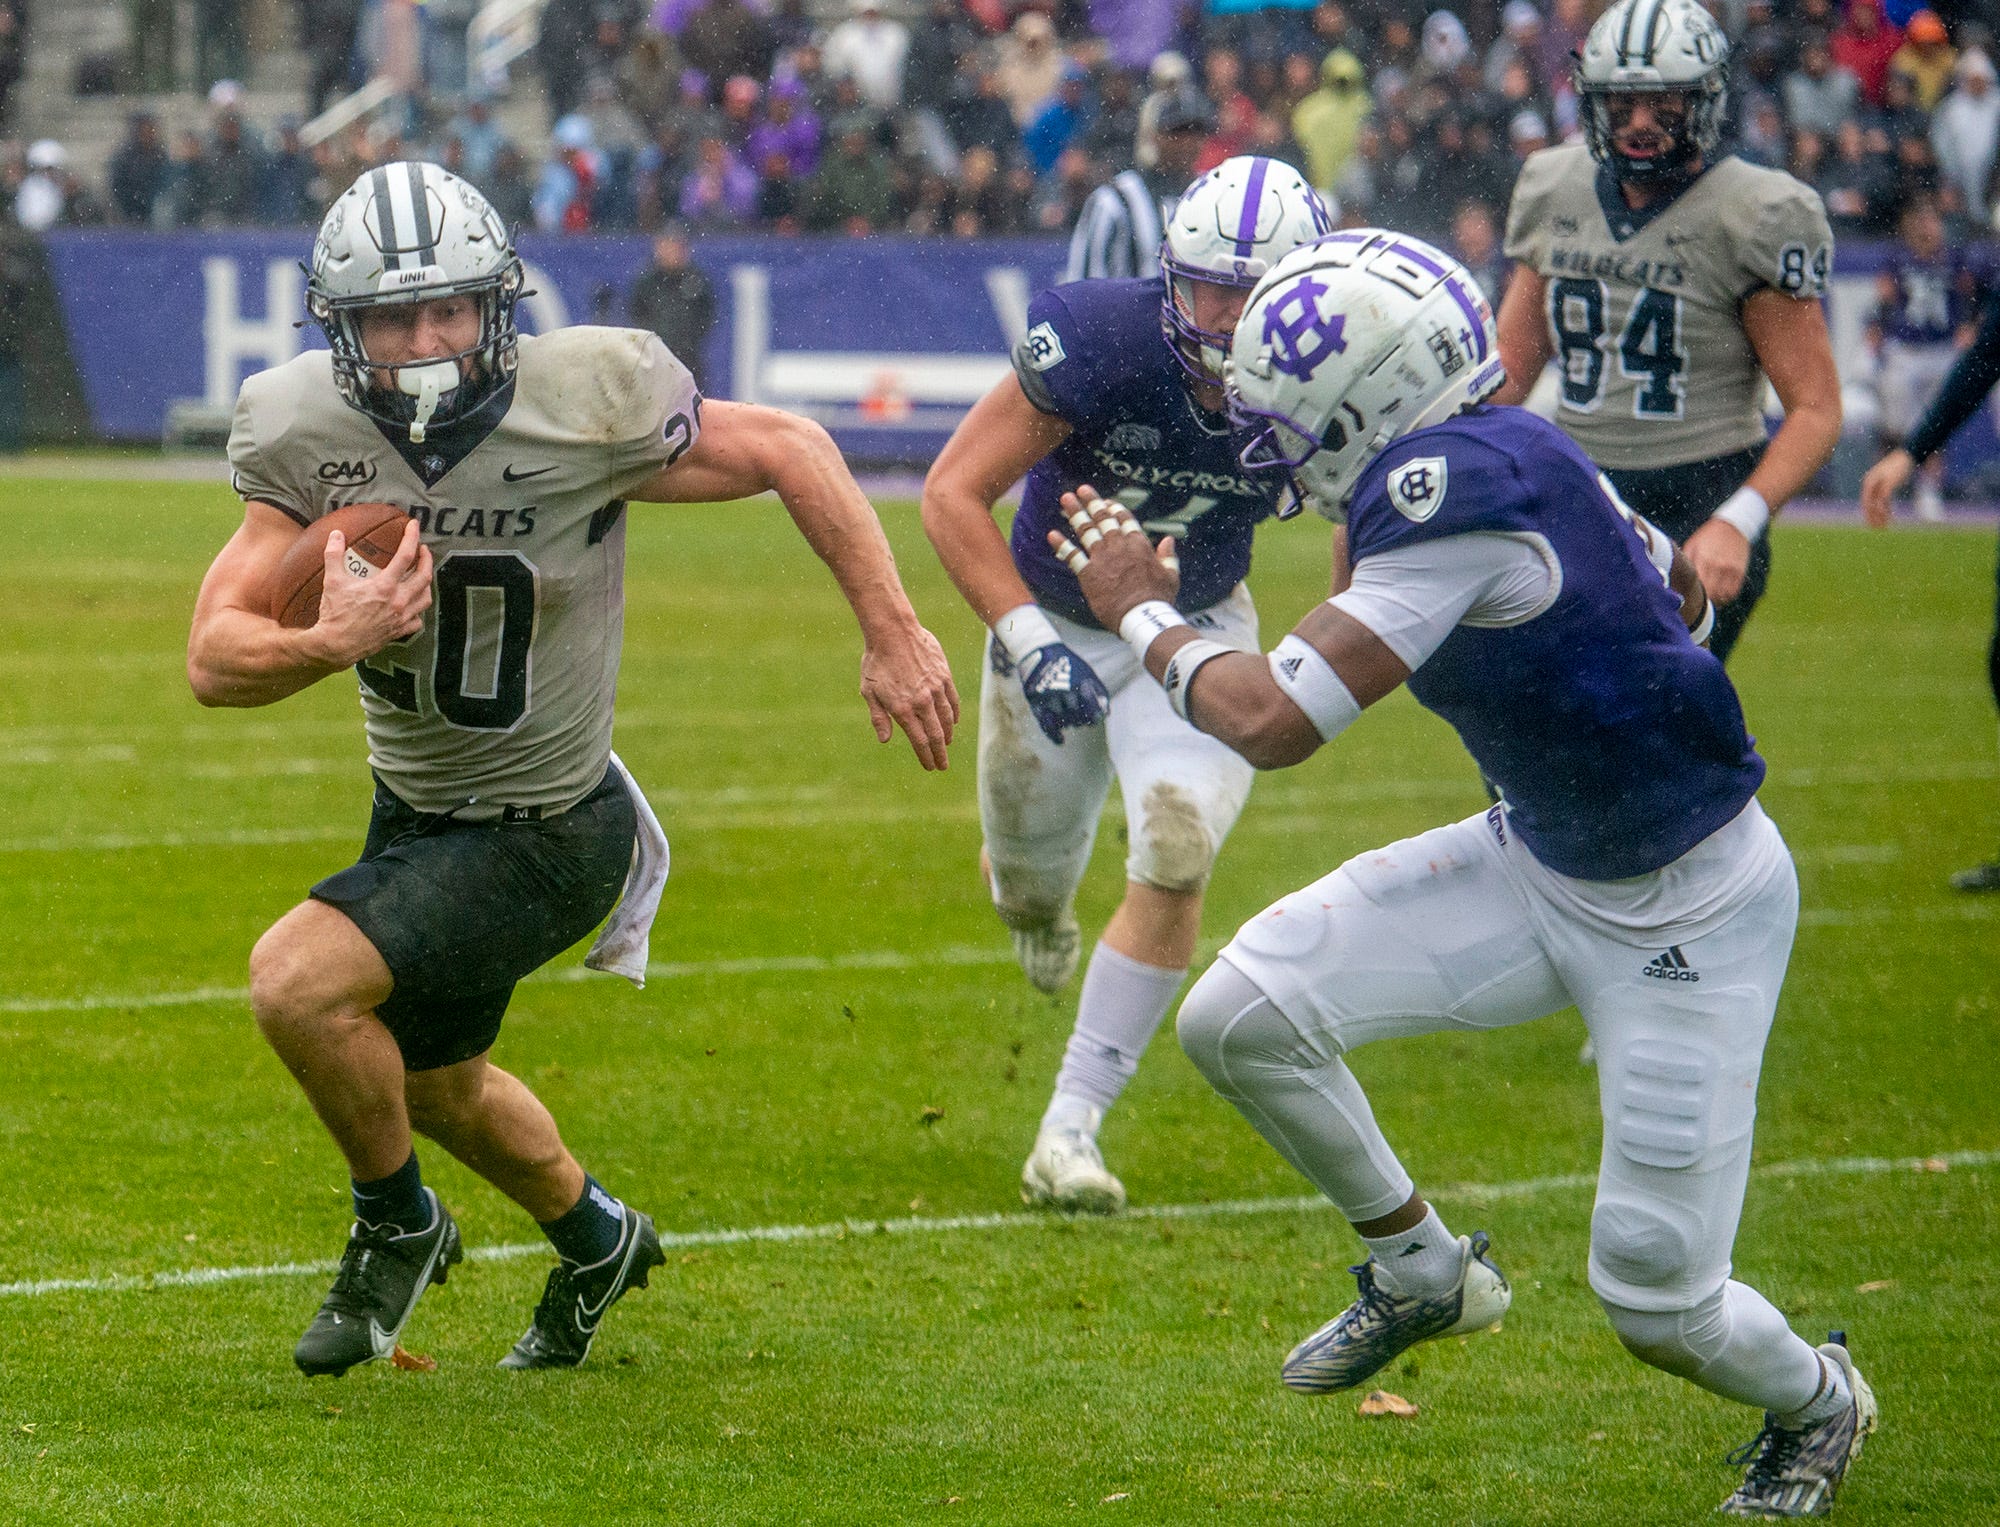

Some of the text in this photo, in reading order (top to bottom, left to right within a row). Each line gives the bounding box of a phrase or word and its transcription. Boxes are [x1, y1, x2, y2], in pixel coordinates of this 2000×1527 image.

[399, 271, 426, 284] UNH
[1778, 243, 1832, 297] 84
[1548, 276, 1689, 421] 84
[317, 461, 368, 480] CAA
[329, 499, 537, 538] DCATS
[348, 560, 369, 578] QB
[1643, 966, 1700, 982] adidas
